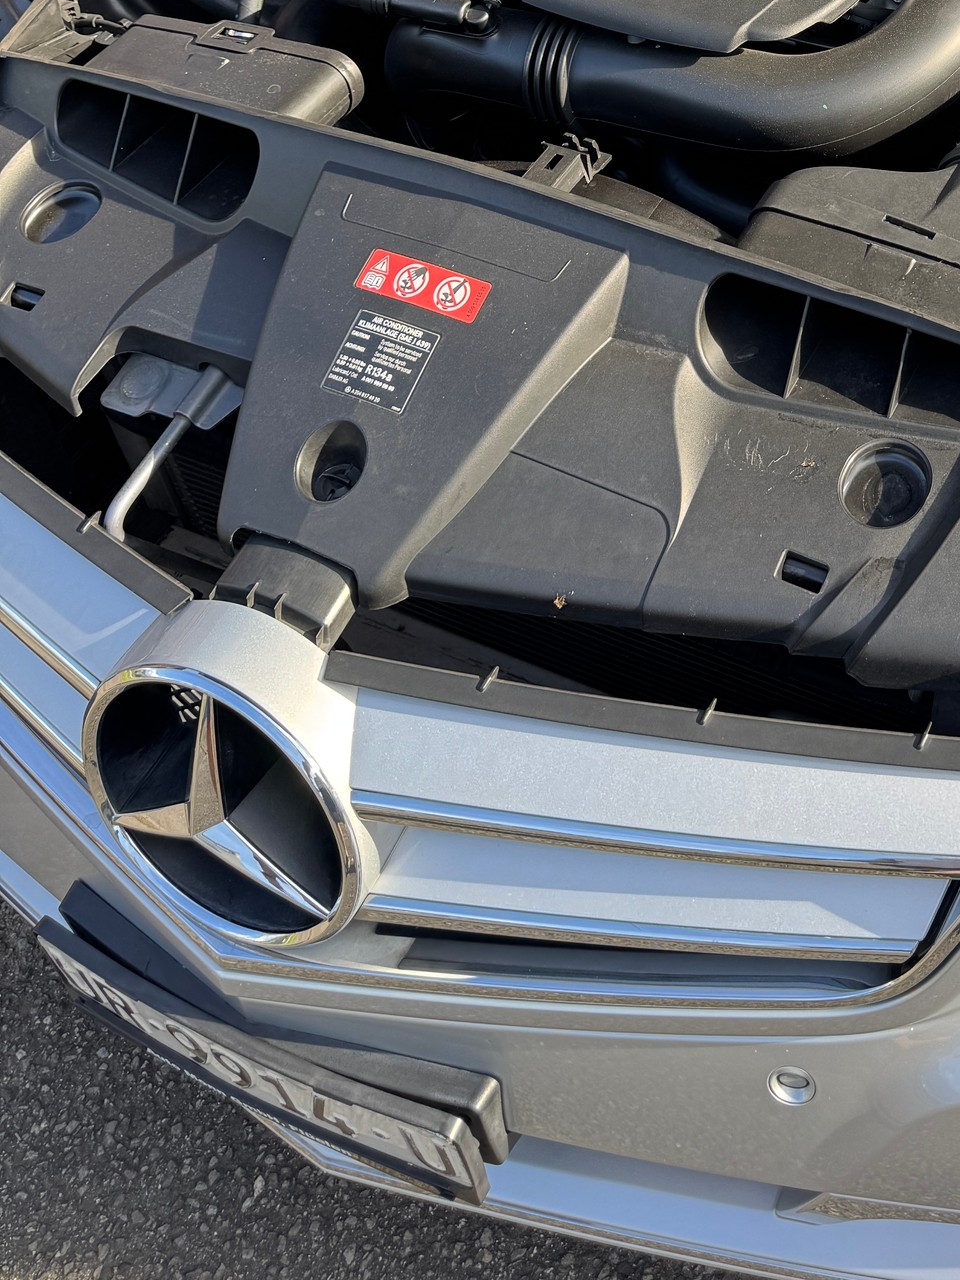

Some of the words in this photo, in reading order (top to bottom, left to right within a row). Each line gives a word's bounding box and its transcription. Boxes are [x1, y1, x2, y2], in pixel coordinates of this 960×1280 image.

[358, 320, 399, 338] KLIMAANLAGE
[397, 333, 413, 344] (SAE
[372, 316, 384, 325] AIR
[383, 320, 424, 338] CONDITIONER
[365, 364, 393, 382] R134a
